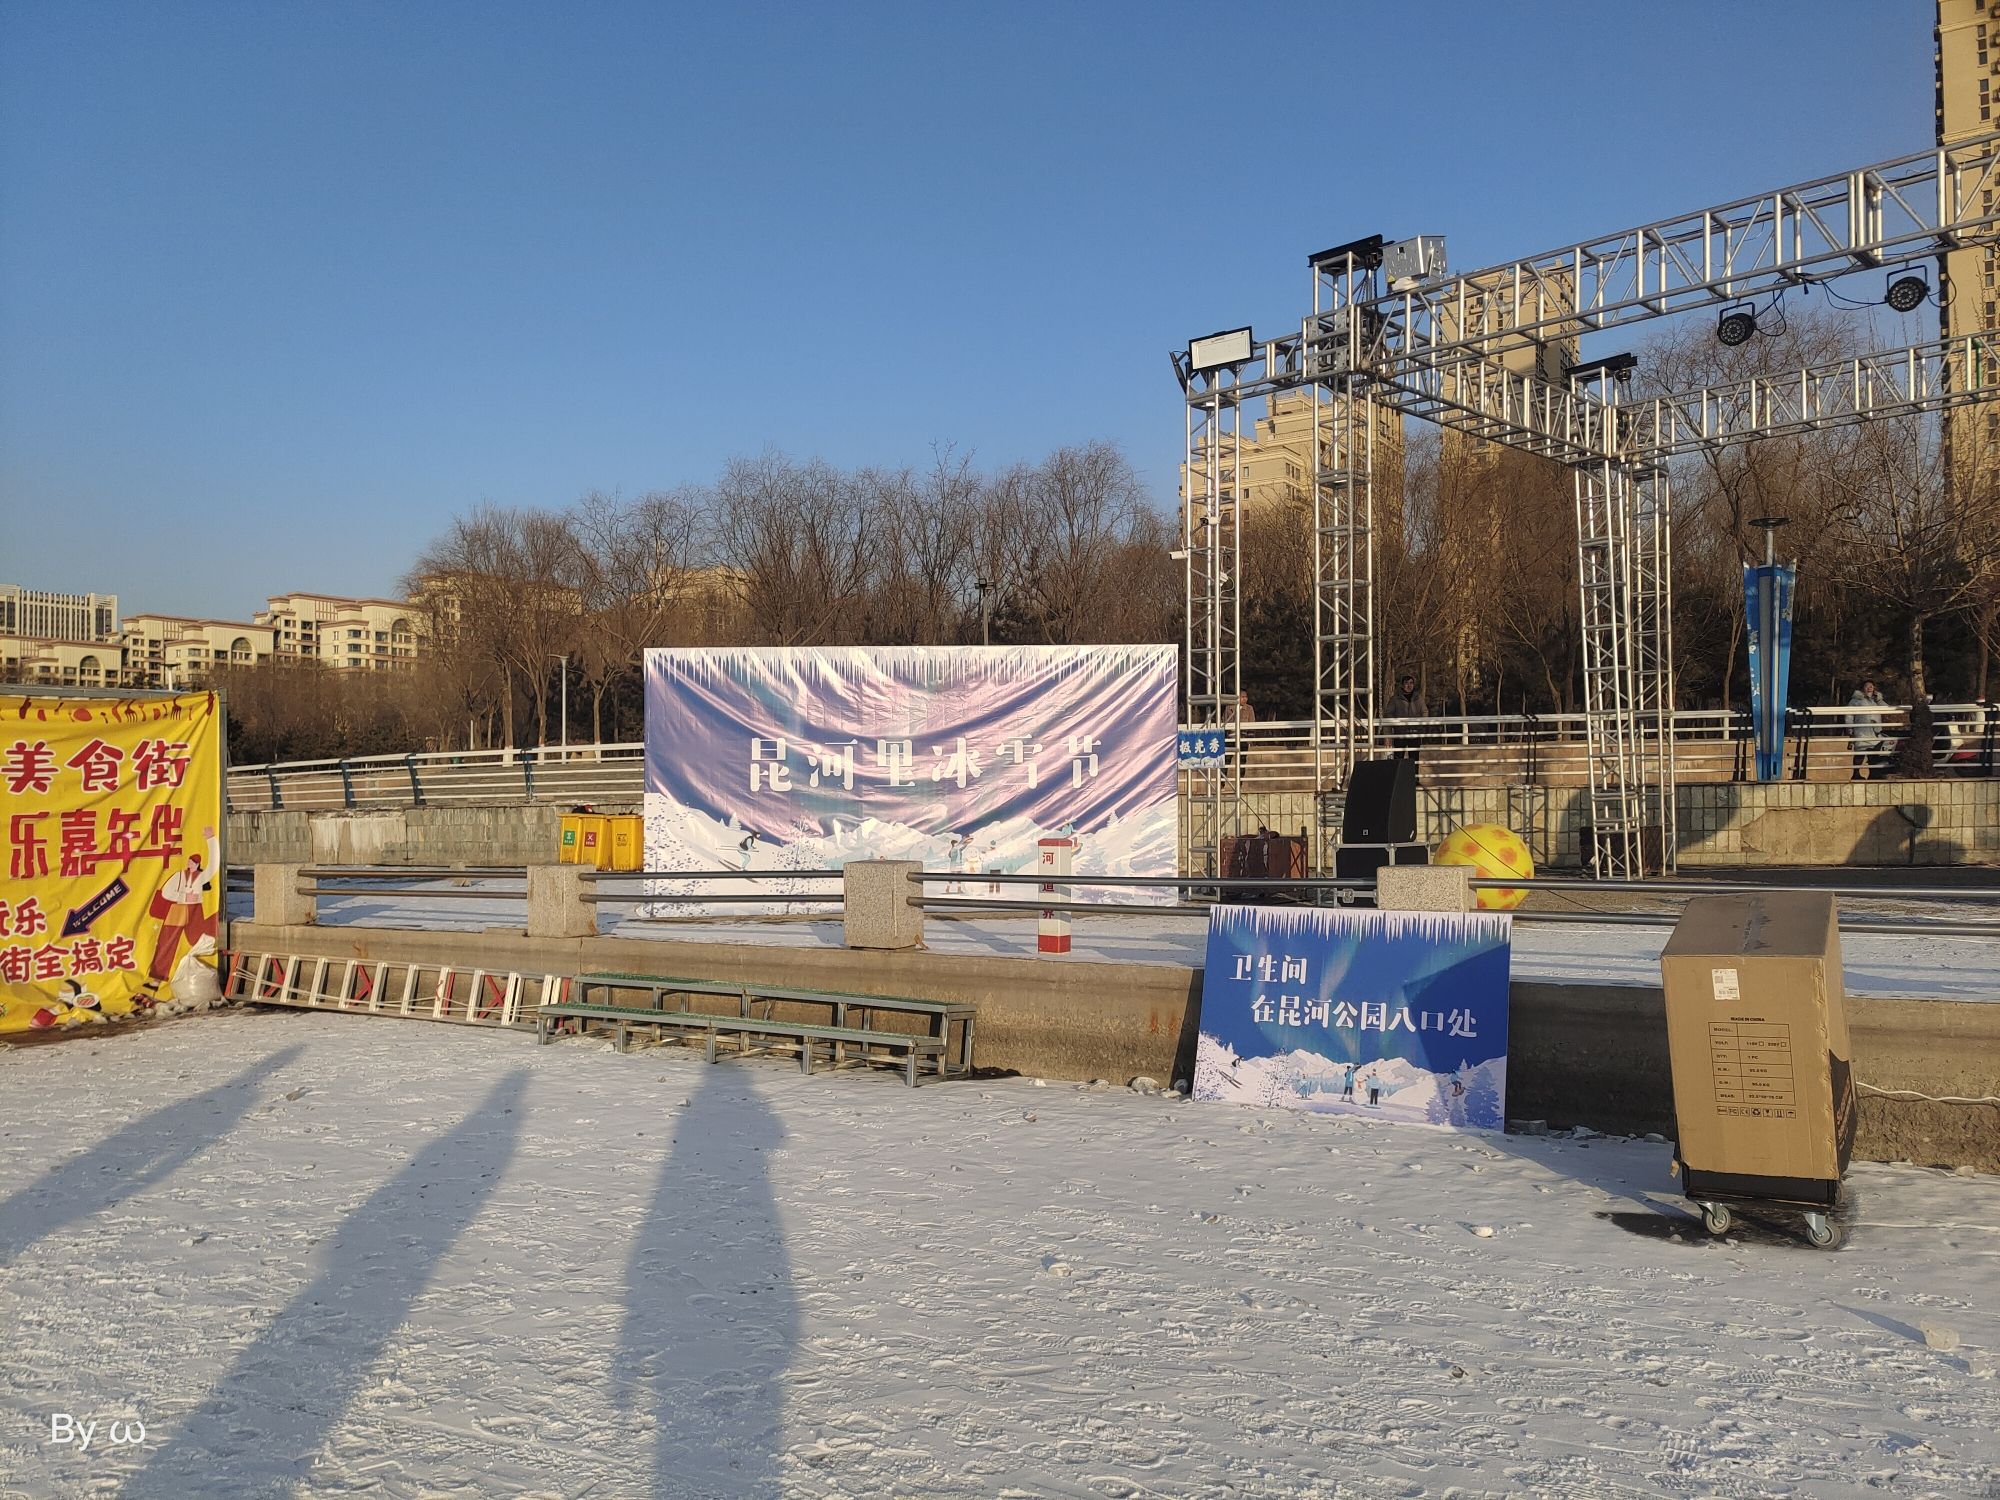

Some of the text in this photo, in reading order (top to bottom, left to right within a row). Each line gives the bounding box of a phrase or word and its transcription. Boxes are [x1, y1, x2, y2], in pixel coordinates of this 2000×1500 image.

[1, 739, 190, 793] 美食街
[748, 734, 1102, 793] 昆河里冰雪节
[9, 803, 183, 879] 乐嘉年华
[72, 884, 122, 928] WELCOME
[0, 936, 136, 983] 街全搞定
[1228, 953, 1308, 985] 卫生间
[1250, 994, 1478, 1038] 在昆河公园入口处
